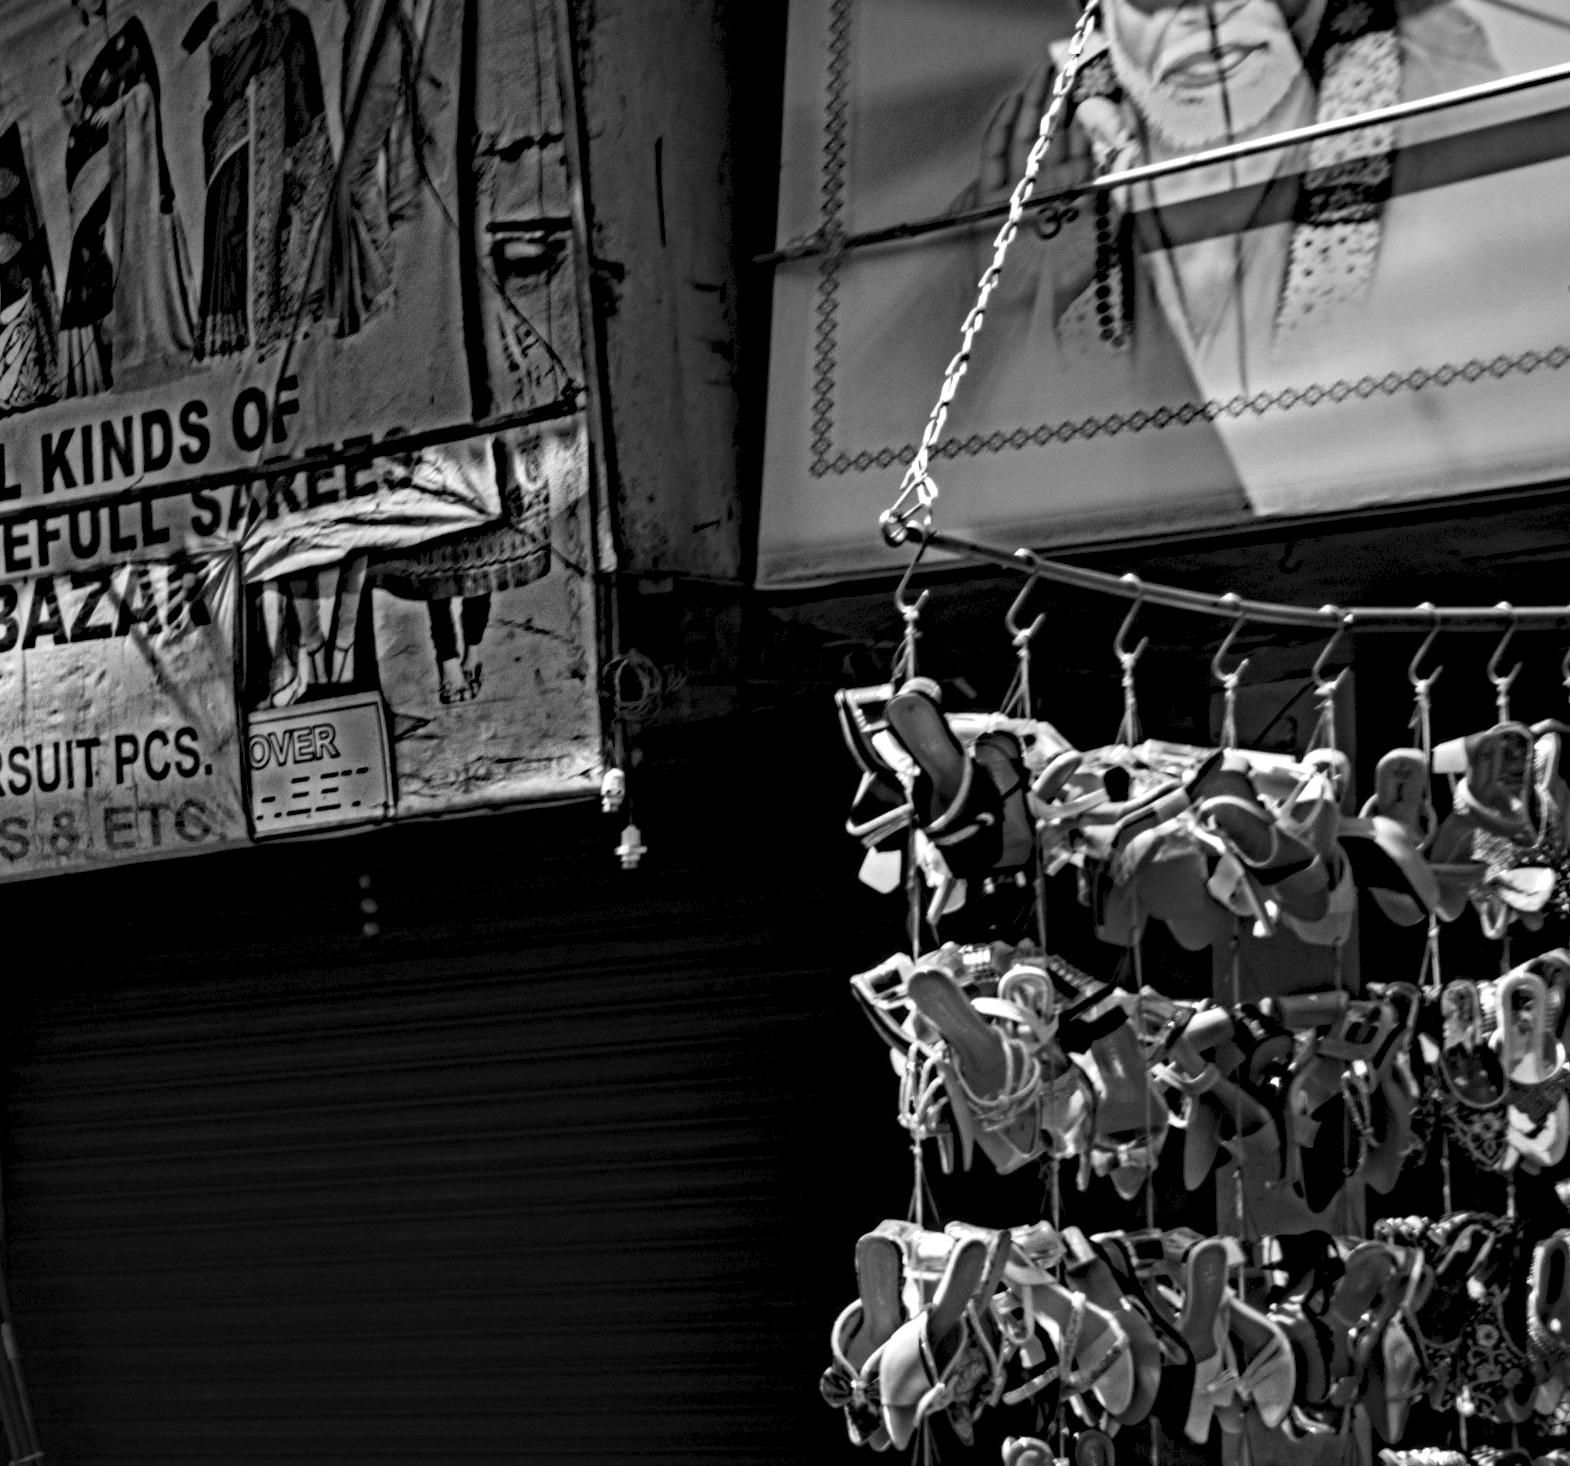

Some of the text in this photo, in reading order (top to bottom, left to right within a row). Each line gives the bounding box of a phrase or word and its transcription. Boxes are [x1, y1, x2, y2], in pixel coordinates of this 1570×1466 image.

[40, 399, 211, 493] KINDS
[231, 375, 301, 452] OF
[113, 725, 213, 786] PCS.
[248, 723, 341, 771] OVER
